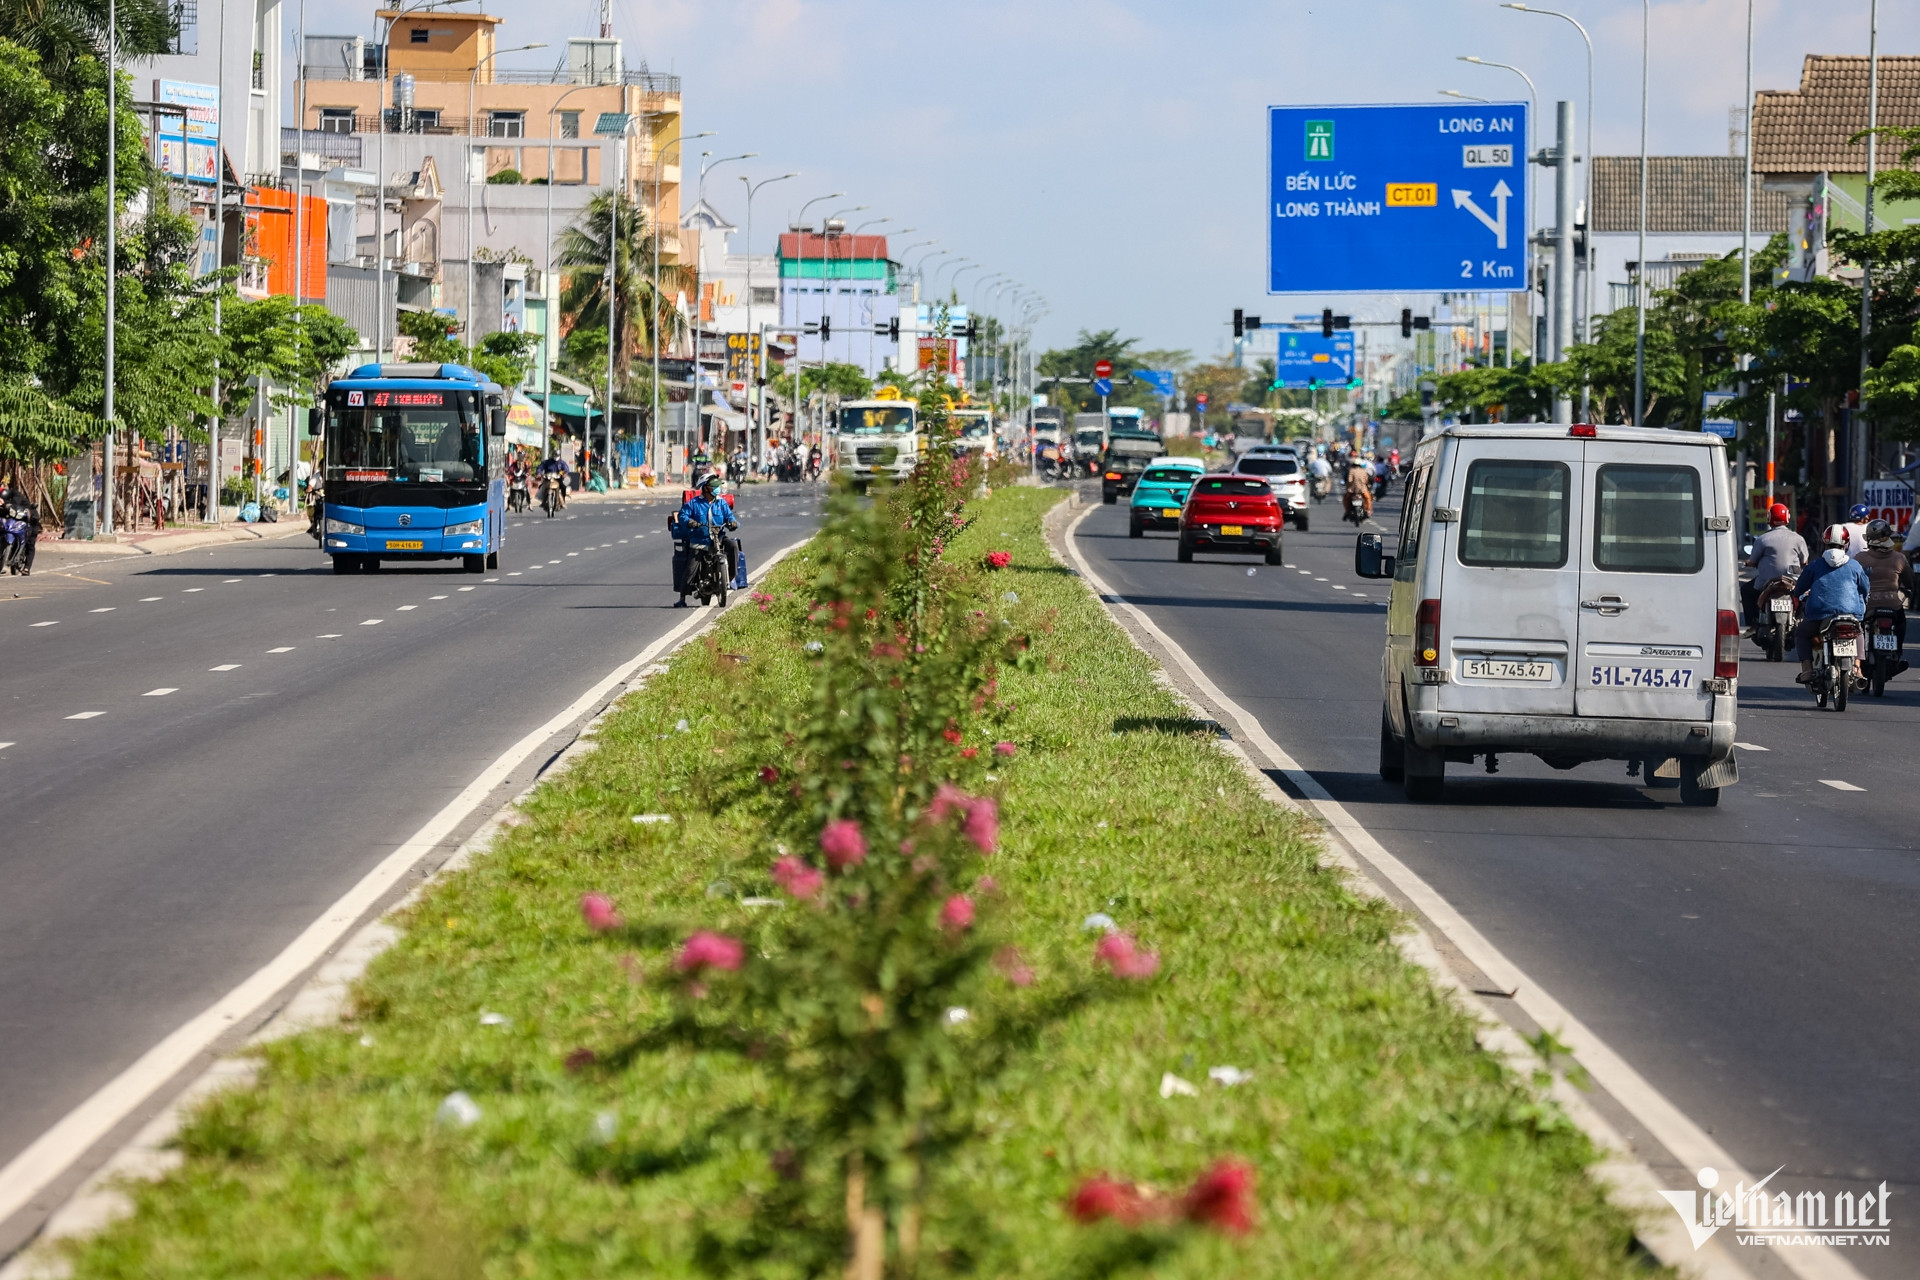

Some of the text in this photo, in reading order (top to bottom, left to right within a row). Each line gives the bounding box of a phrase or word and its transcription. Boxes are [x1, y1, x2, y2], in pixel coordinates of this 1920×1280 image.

[1439, 118, 1514, 133] LONG AN
[1466, 149, 1509, 163] QL.50
[1286, 170, 1357, 191] BẾN LỨC
[1393, 188, 1431, 203] CT.01
[1276, 197, 1380, 218] LONG THÀNH
[1460, 259, 1514, 279] 2 Km
[349, 393, 362, 405] 47
[374, 392, 390, 406] 47
[1886, 484, 1914, 507] RIÊNG
[1470, 661, 1545, 678] 51L-745.47
[1591, 667, 1692, 688] 51L-745.47
